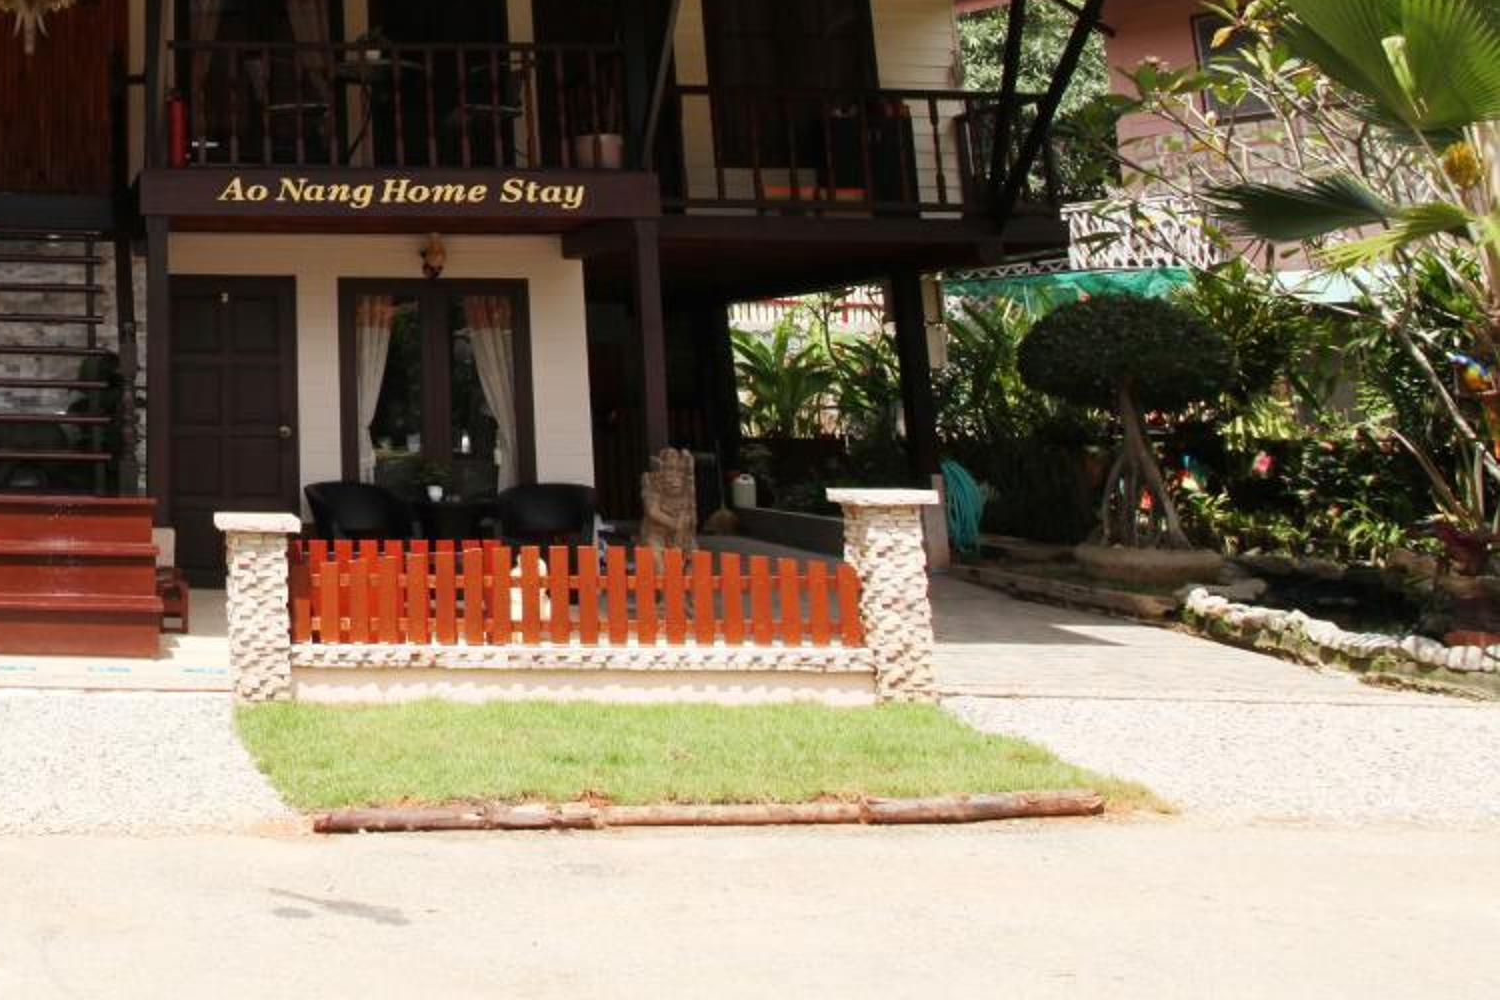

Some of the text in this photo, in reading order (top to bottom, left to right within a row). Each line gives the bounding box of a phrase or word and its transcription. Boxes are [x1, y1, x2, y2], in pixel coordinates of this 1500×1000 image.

[217, 176, 585, 210] Ao Nang Home Stay
